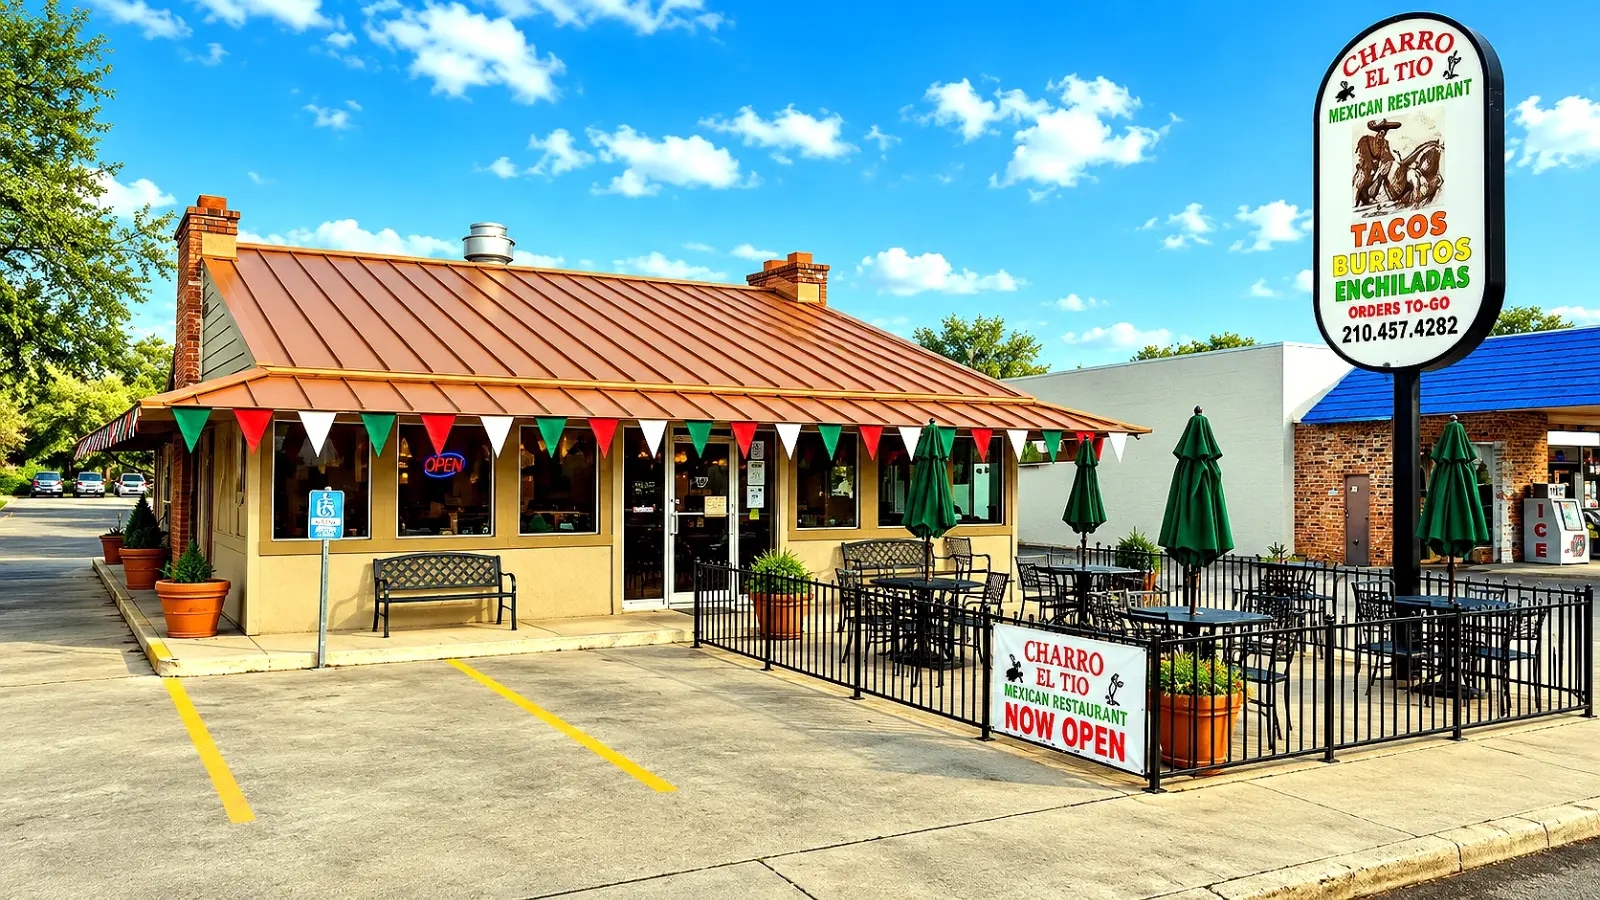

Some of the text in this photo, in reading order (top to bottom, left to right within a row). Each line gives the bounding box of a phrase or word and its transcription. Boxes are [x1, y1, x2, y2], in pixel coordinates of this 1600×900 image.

[1342, 30, 1454, 76] CHARRO
[1365, 56, 1433, 89] EL TIO
[1329, 79, 1472, 124] MEXICAN RESTAURANT
[1350, 210, 1448, 248] TACOS
[1333, 236, 1472, 278] BURRITOS
[1335, 265, 1470, 302] ENCHILADAS
[1348, 296, 1450, 319] ORDERS TO-GO
[1342, 315, 1458, 343] 210.457.4282
[425, 457, 462, 472] OPEN
[1534, 503, 1547, 558] ICE
[1024, 640, 1104, 677] CHARRO
[1036, 667, 1090, 696] EL TIO
[1004, 683, 1128, 727] MEXICAN RESTAURANT
[1005, 702, 1125, 763] NOW OPEN
